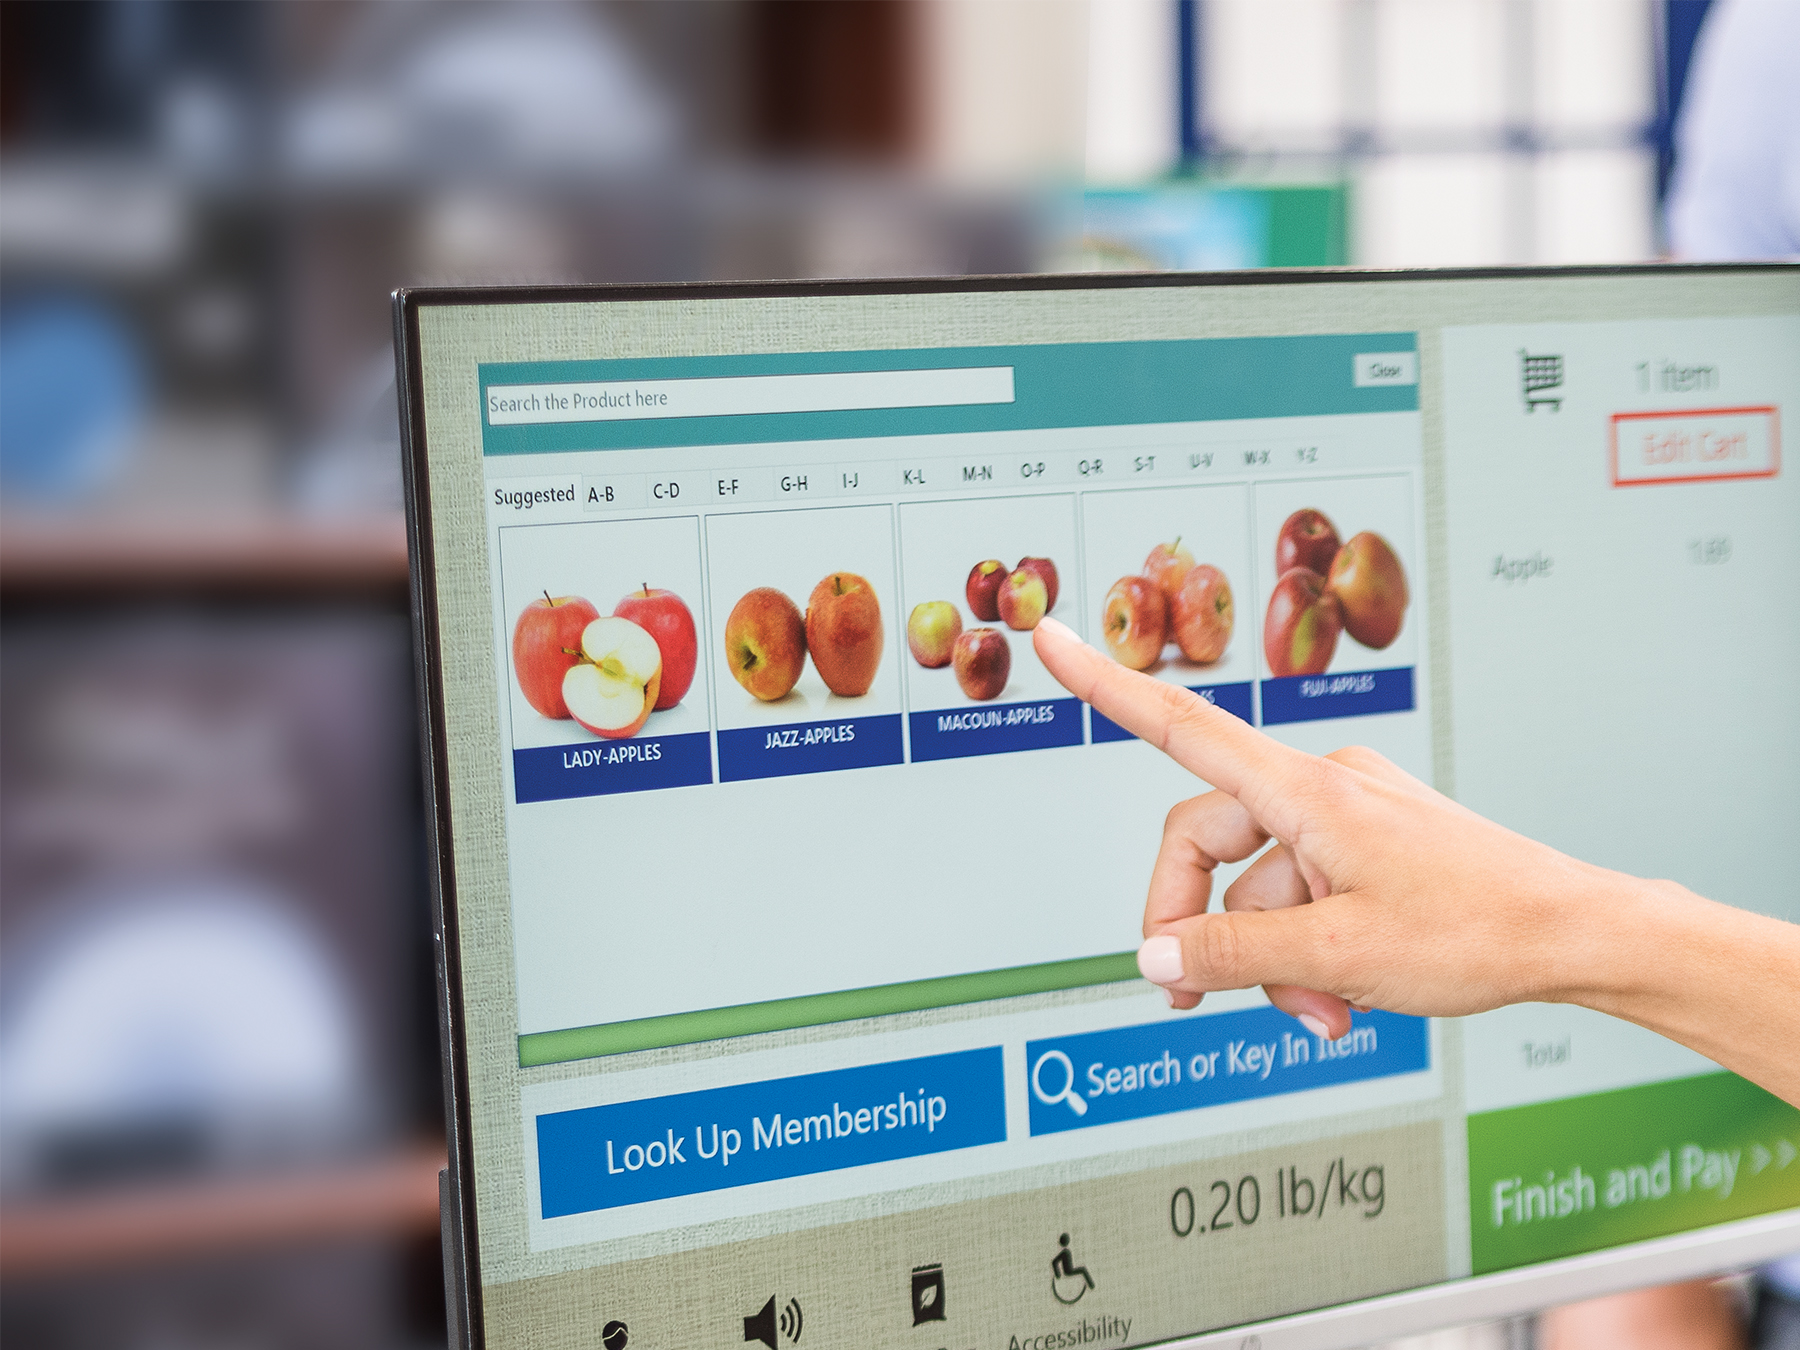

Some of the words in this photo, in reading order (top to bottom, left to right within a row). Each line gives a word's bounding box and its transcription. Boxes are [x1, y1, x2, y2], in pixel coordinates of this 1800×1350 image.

[1636, 361, 1651, 392] 1
[1661, 359, 1717, 392] item
[489, 392, 540, 414] Search
[544, 391, 569, 412] the
[573, 389, 631, 410] Product
[634, 388, 668, 407] here
[1640, 432, 1690, 464] Edit
[1697, 429, 1748, 461] Cart
[494, 484, 575, 510] Suggested
[587, 486, 615, 503] A-B
[653, 482, 680, 500] C-D
[718, 479, 739, 496] E-F
[780, 475, 809, 493] G-H
[842, 473, 859, 489] I-J
[903, 468, 926, 486] K-L
[963, 465, 993, 483] M-N
[1020, 462, 1046, 479] O-P
[1078, 459, 1104, 477] Q-R
[1134, 456, 1156, 473] S-T
[1492, 551, 1553, 582] Apple
[937, 705, 1055, 732] MACOUN-APPLES
[764, 724, 856, 750] JAZZ-APPLES
[563, 744, 662, 769] LADY-APPLES
[1087, 1052, 1181, 1098] Search
[1190, 1050, 1219, 1079] or
[1227, 1039, 1277, 1080] Key
[1283, 1033, 1310, 1065] In
[1523, 1039, 1569, 1067] Total
[606, 1130, 687, 1174] Look
[696, 1123, 742, 1166] Up
[752, 1088, 947, 1151] Membership
[1170, 1174, 1261, 1238] 0.20
[1277, 1157, 1386, 1219] lb/kg
[1492, 1165, 1596, 1229] Finish
[1605, 1149, 1671, 1207] and
[1679, 1143, 1741, 1199] Pay
